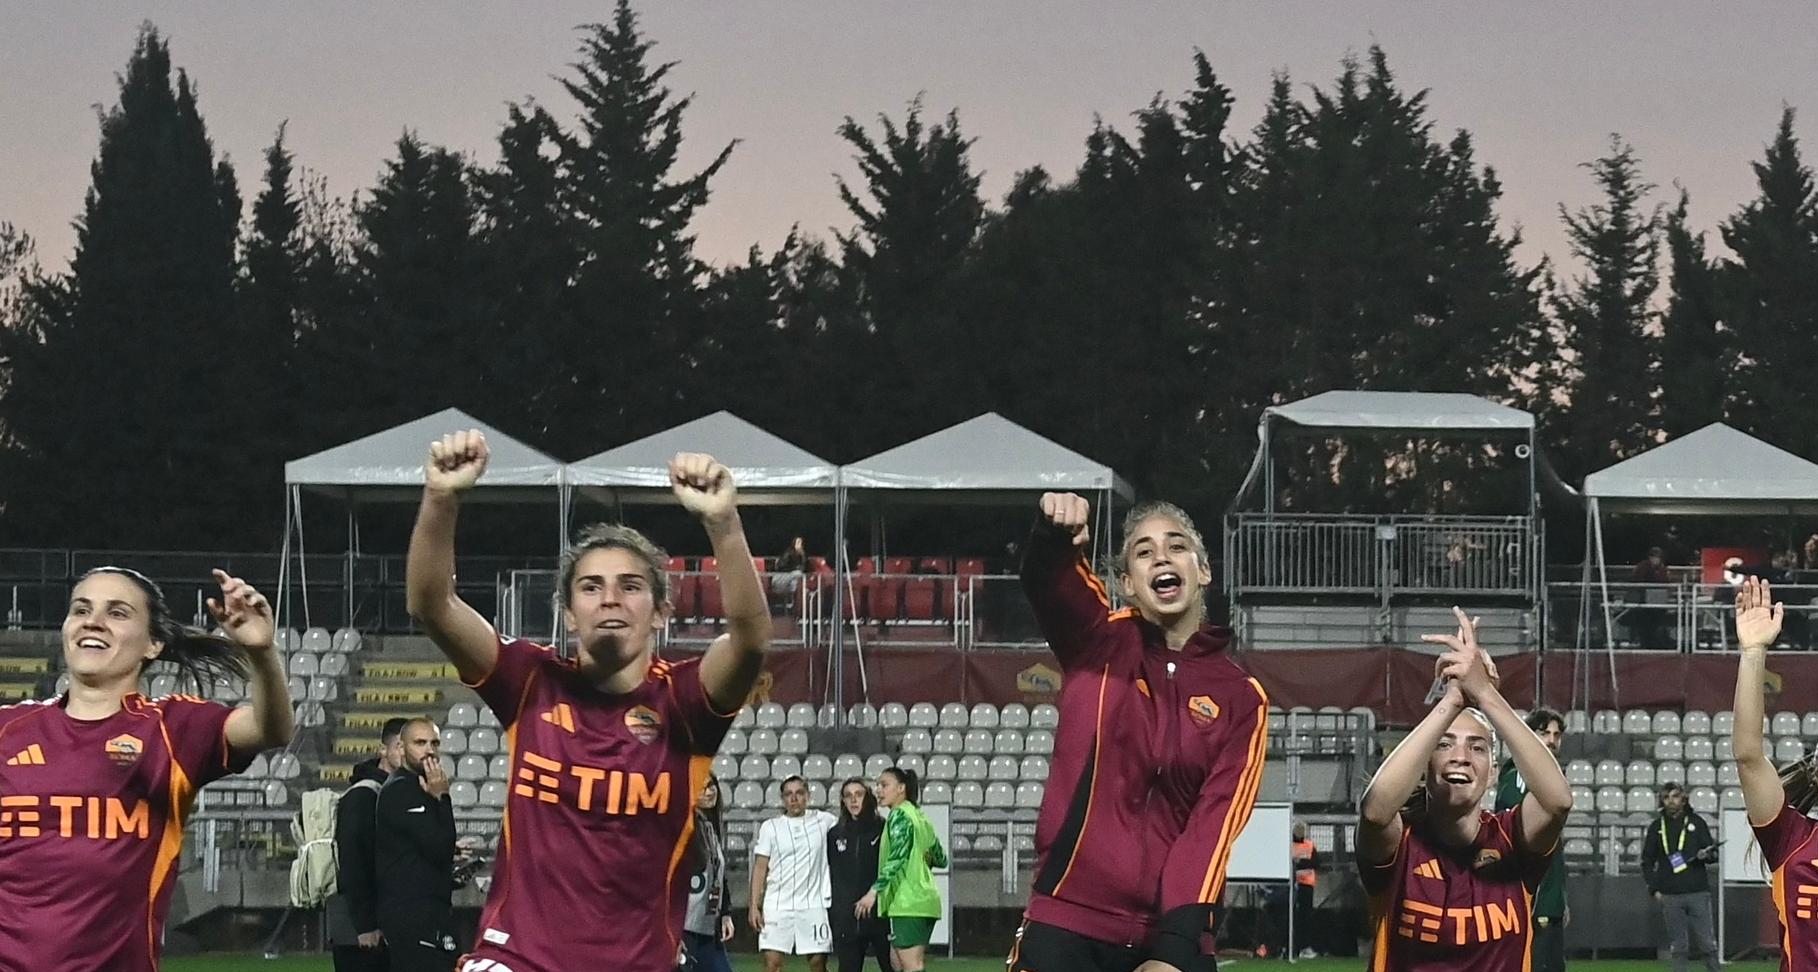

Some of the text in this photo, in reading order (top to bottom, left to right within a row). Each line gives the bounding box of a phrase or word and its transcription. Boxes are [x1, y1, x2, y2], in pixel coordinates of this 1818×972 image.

[571, 765, 671, 815] TIM
[50, 796, 149, 840] TIM
[812, 923, 829, 942] 10
[1447, 899, 1521, 945] TIM
